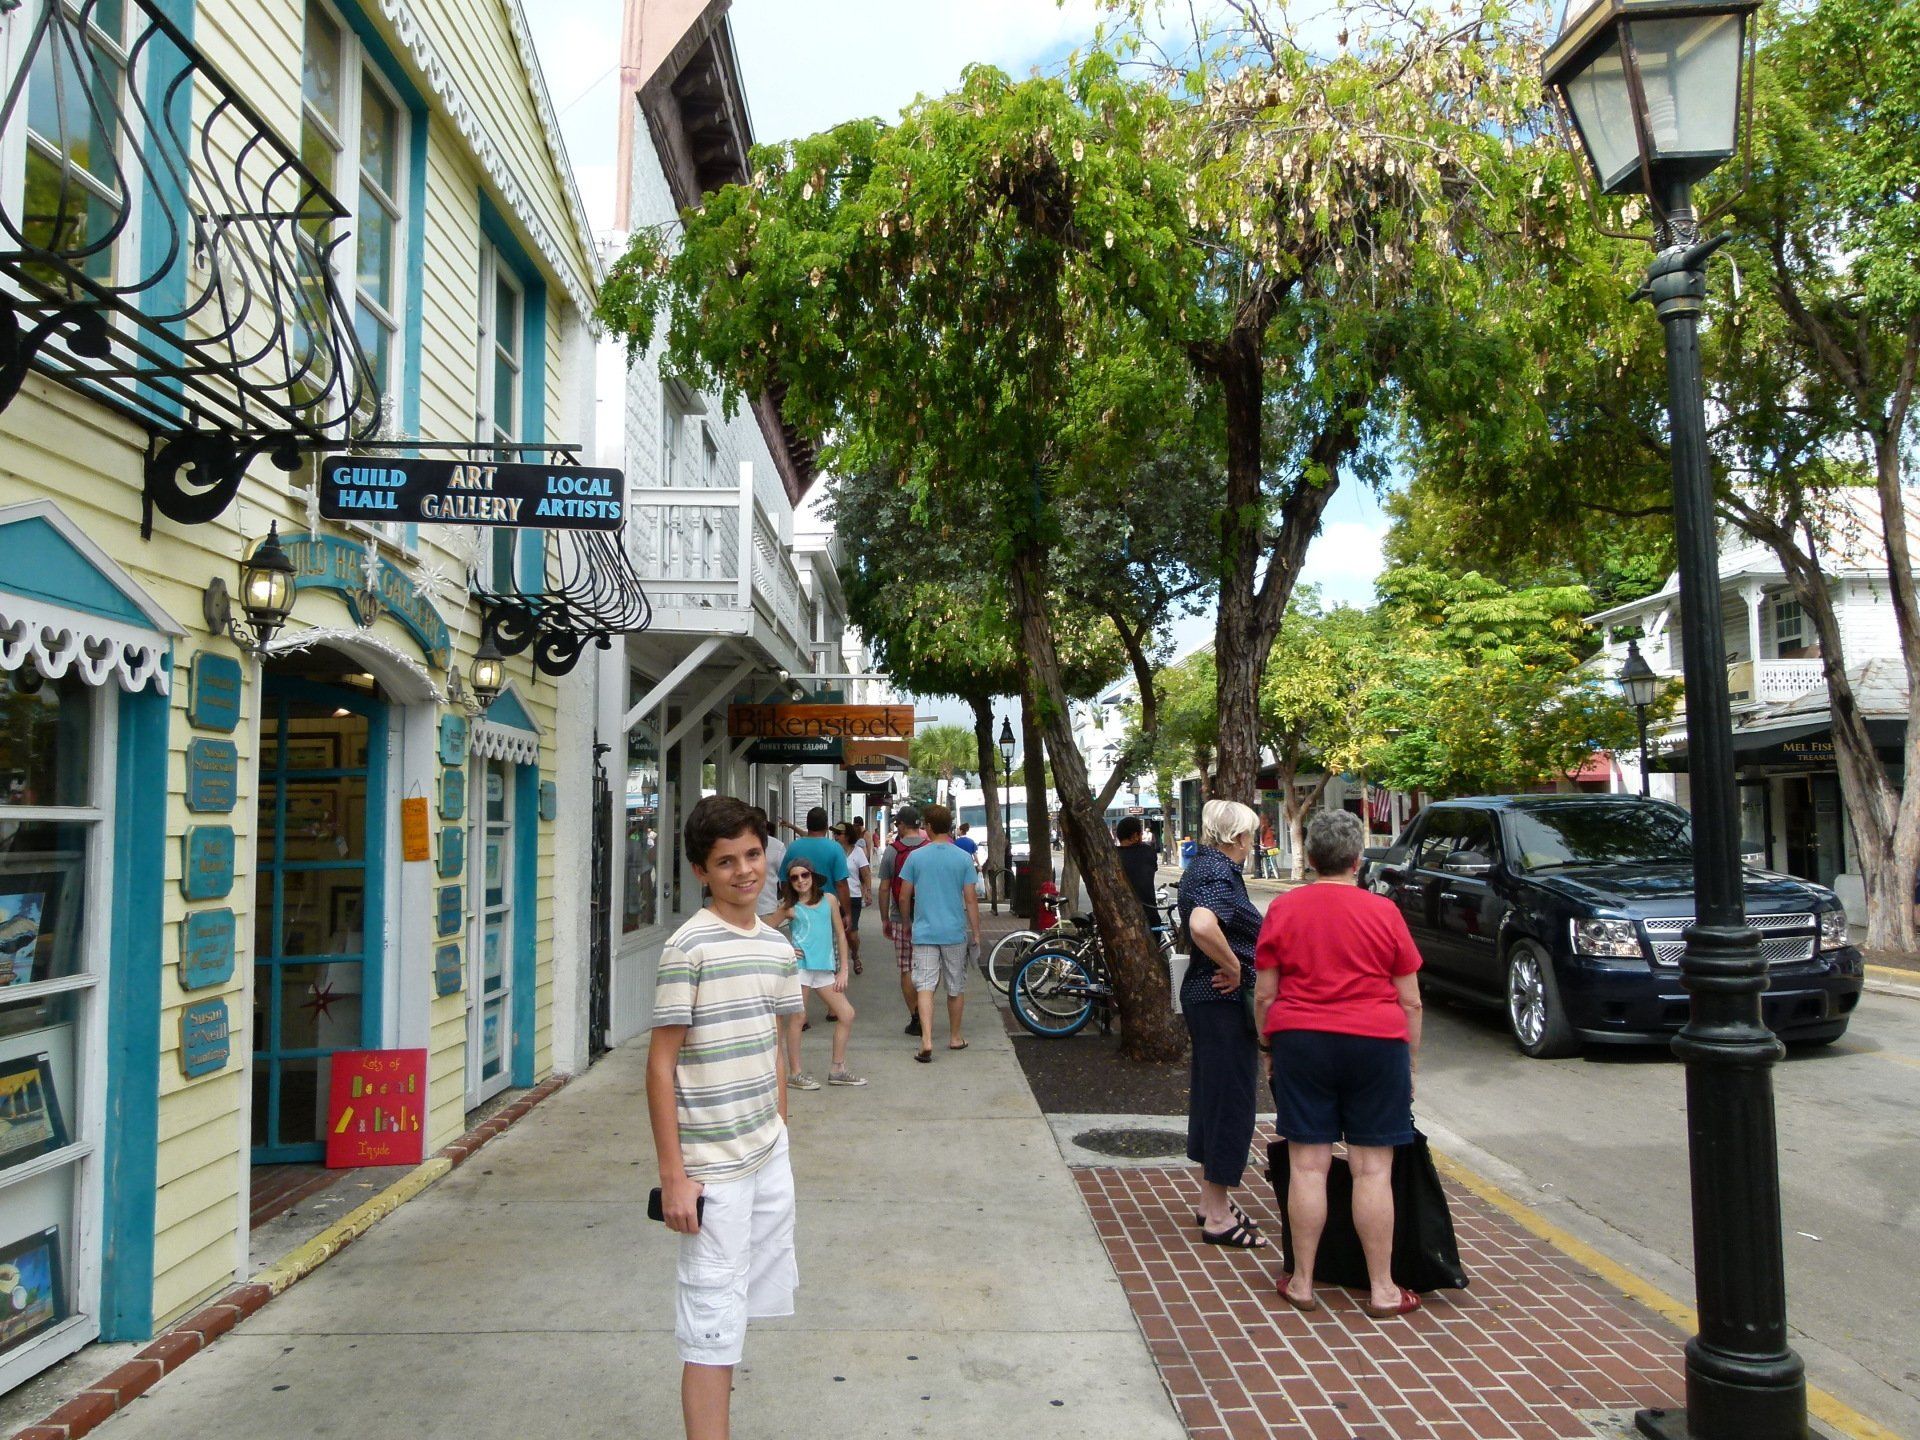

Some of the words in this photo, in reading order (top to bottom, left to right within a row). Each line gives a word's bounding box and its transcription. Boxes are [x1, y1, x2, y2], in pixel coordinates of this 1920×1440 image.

[333, 467, 407, 488] GUILD
[447, 465, 498, 490] ART
[547, 476, 613, 497] LOCAL
[338, 489, 399, 510] HALL
[420, 494, 523, 522] GALLERY
[535, 498, 621, 519] ARTISTS
[279, 543, 328, 577] UILD
[802, 743, 828, 751] SALOON
[1783, 743, 1808, 752] MEL
[1811, 742, 1836, 752] FISH
[190, 1009, 223, 1024] Susan
